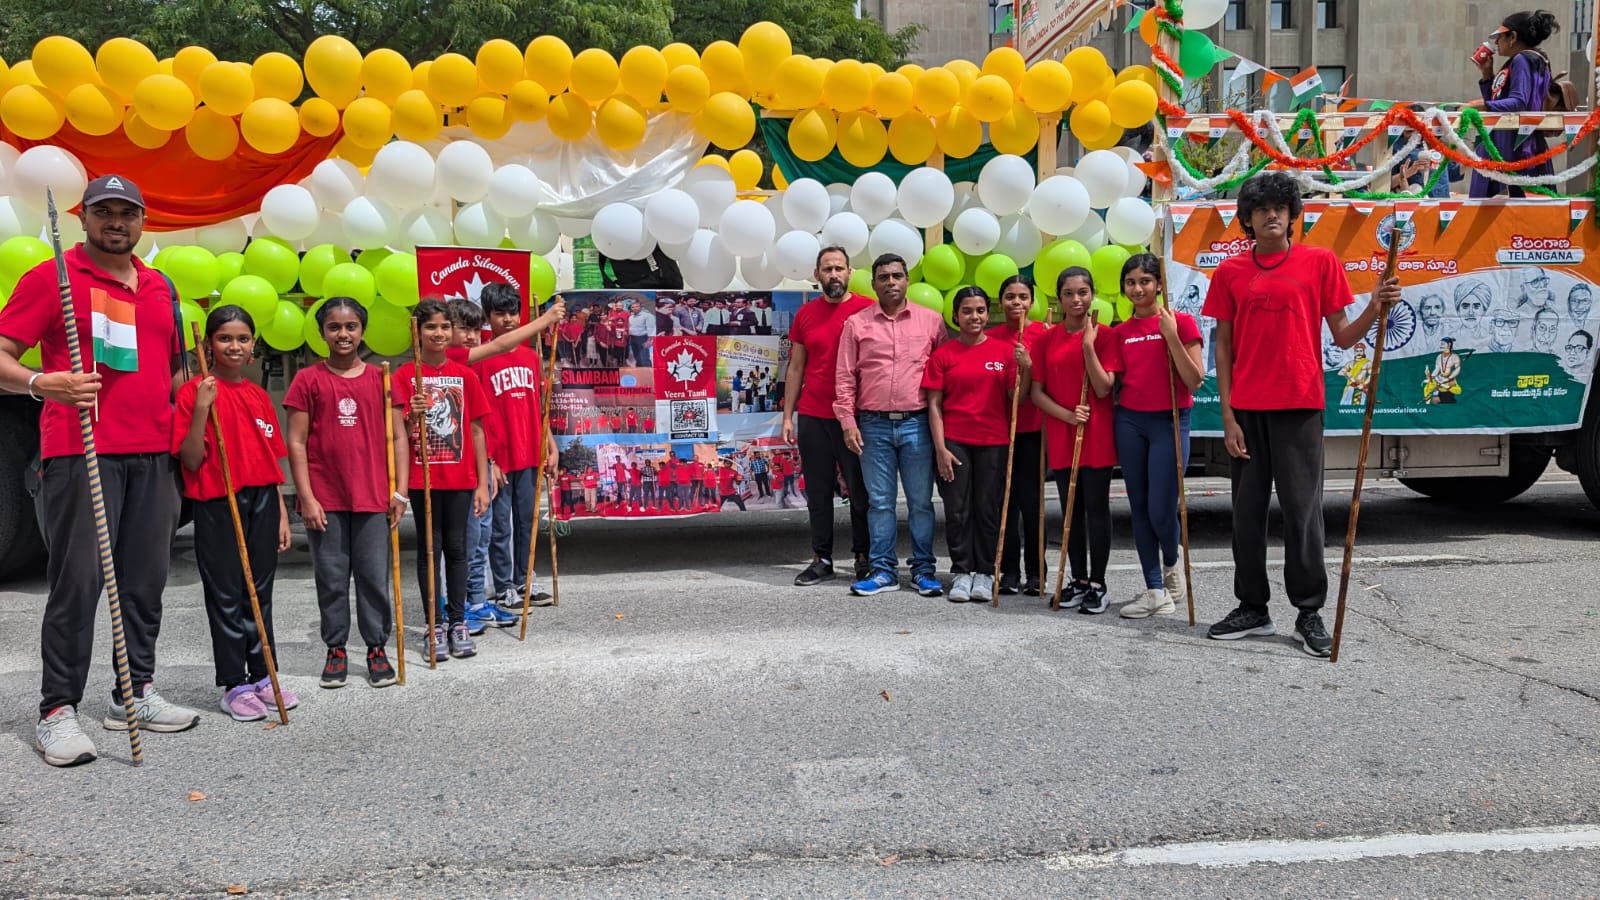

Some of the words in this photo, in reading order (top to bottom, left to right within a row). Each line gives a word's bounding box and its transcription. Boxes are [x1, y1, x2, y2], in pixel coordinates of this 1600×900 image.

[1512, 236, 1570, 249] తెలంగాణ
[1199, 255, 1231, 264] ANDH
[1508, 251, 1573, 260] TELANGANA
[431, 256, 470, 285] Canada
[1345, 260, 1368, 271] జాతి
[1398, 261, 1425, 270] తాకా
[440, 377, 462, 385] TIGER
[490, 366, 535, 396] VENIC
